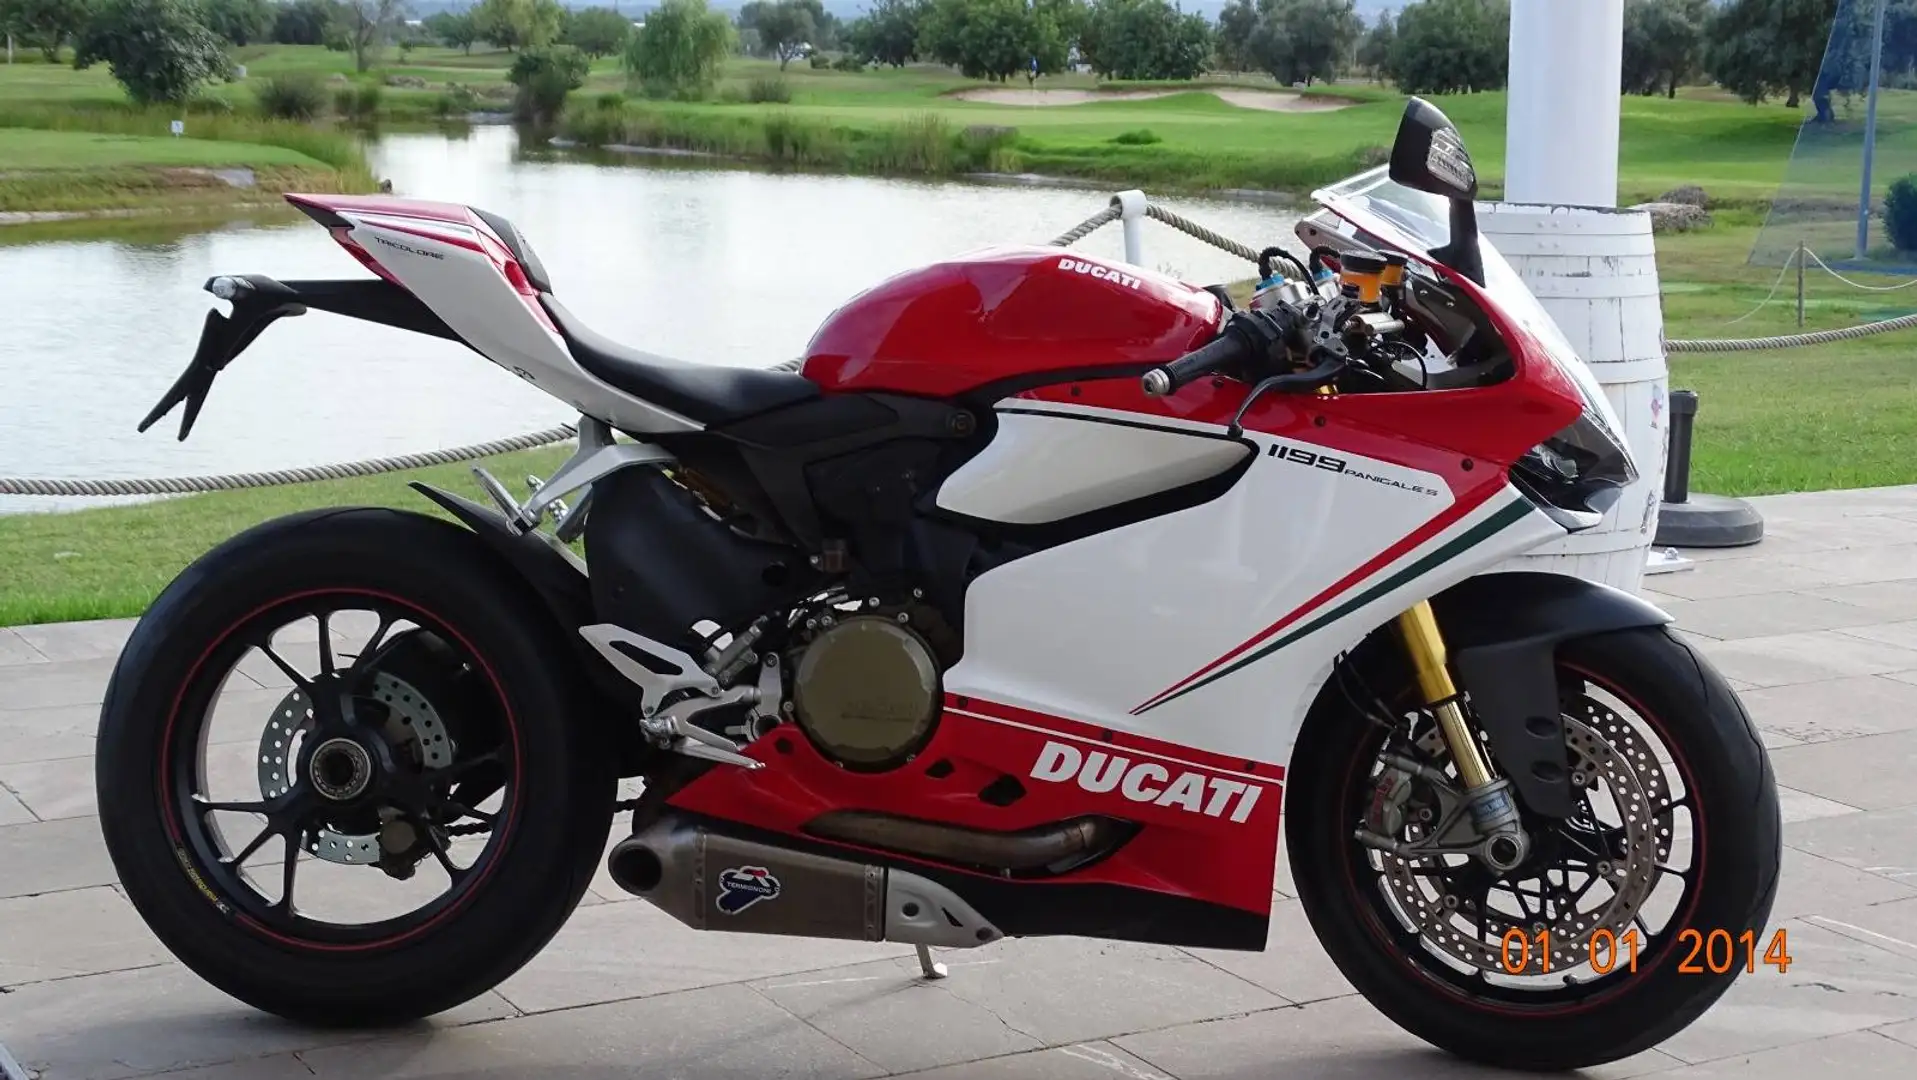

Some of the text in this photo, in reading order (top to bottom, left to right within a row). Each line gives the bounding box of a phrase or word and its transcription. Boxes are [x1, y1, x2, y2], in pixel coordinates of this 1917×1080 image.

[374, 236, 444, 260] TRICOLORE
[1057, 258, 1142, 290] DUCATI
[1267, 443, 1438, 496] 1199 PANIGALE S
[1029, 740, 1263, 824] DUCATI
